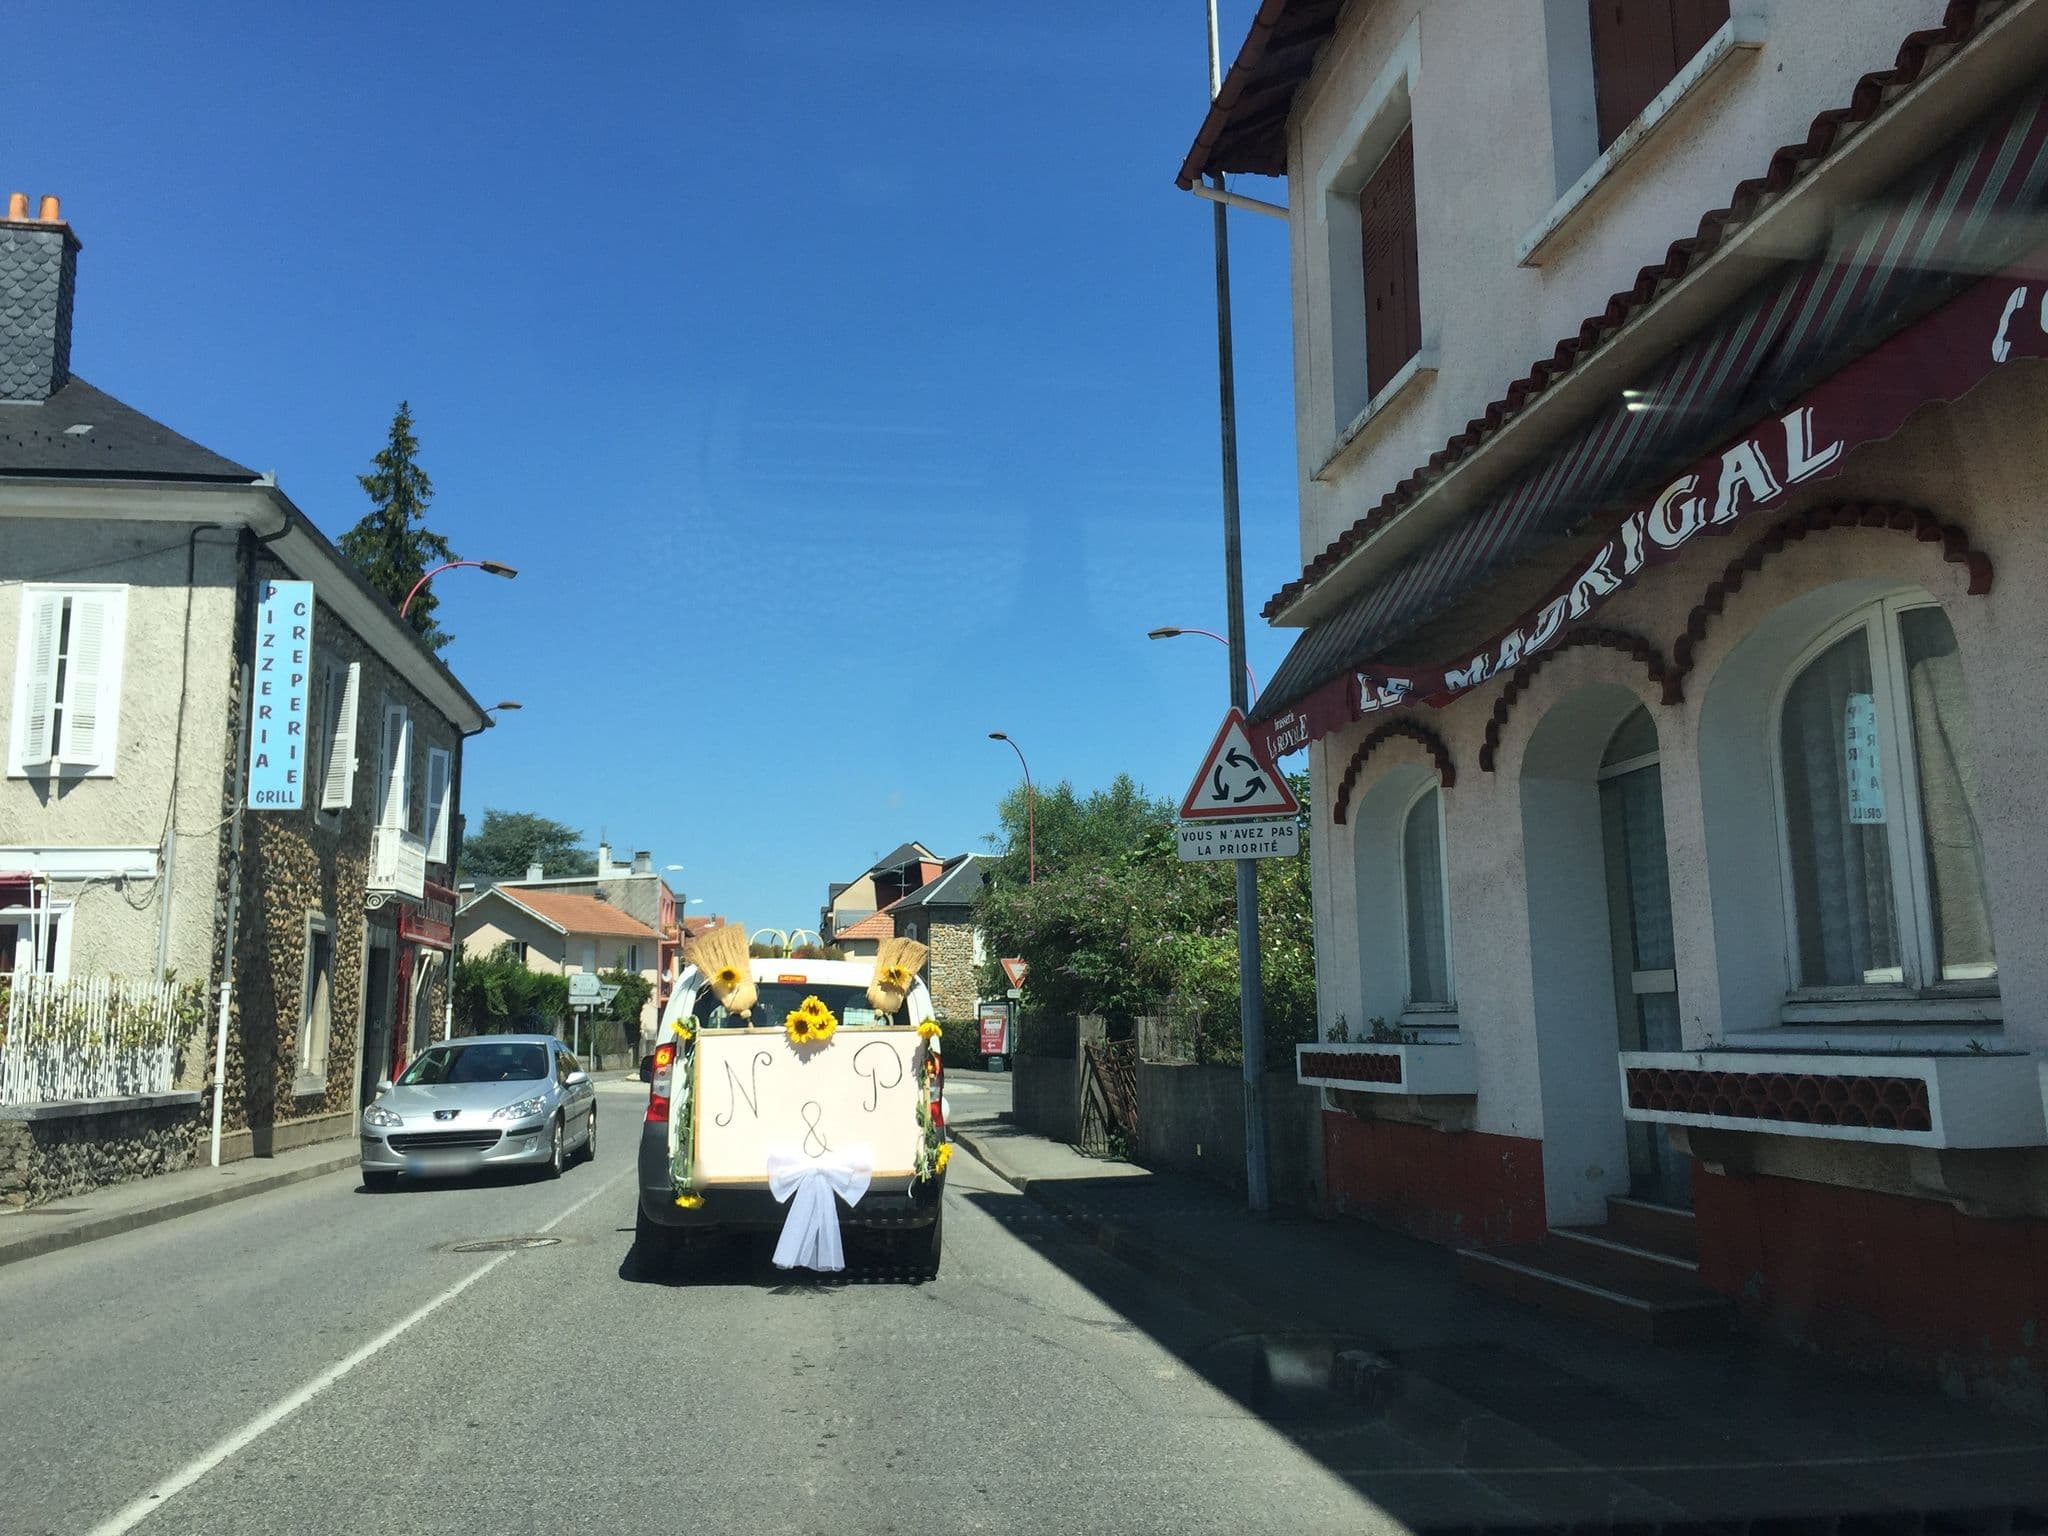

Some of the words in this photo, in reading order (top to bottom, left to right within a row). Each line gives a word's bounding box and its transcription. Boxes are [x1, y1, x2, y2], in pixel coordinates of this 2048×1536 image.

[1356, 672, 1413, 712] LE
[1443, 406, 1845, 691] MADRIGAL
[256, 586, 278, 769] PIZZERIA
[287, 602, 306, 784] CREPERIE
[256, 790, 296, 804] GRILL
[1181, 831, 1213, 842] VOUS
[1220, 828, 1264, 840] N'AVEZ
[1271, 826, 1294, 837] PAS
[1197, 846, 1212, 856] LA
[1220, 840, 1279, 855] PRIORITÉ
[714, 1051, 773, 1127] N
[853, 1041, 903, 1113] P
[801, 1101, 833, 1158] &
